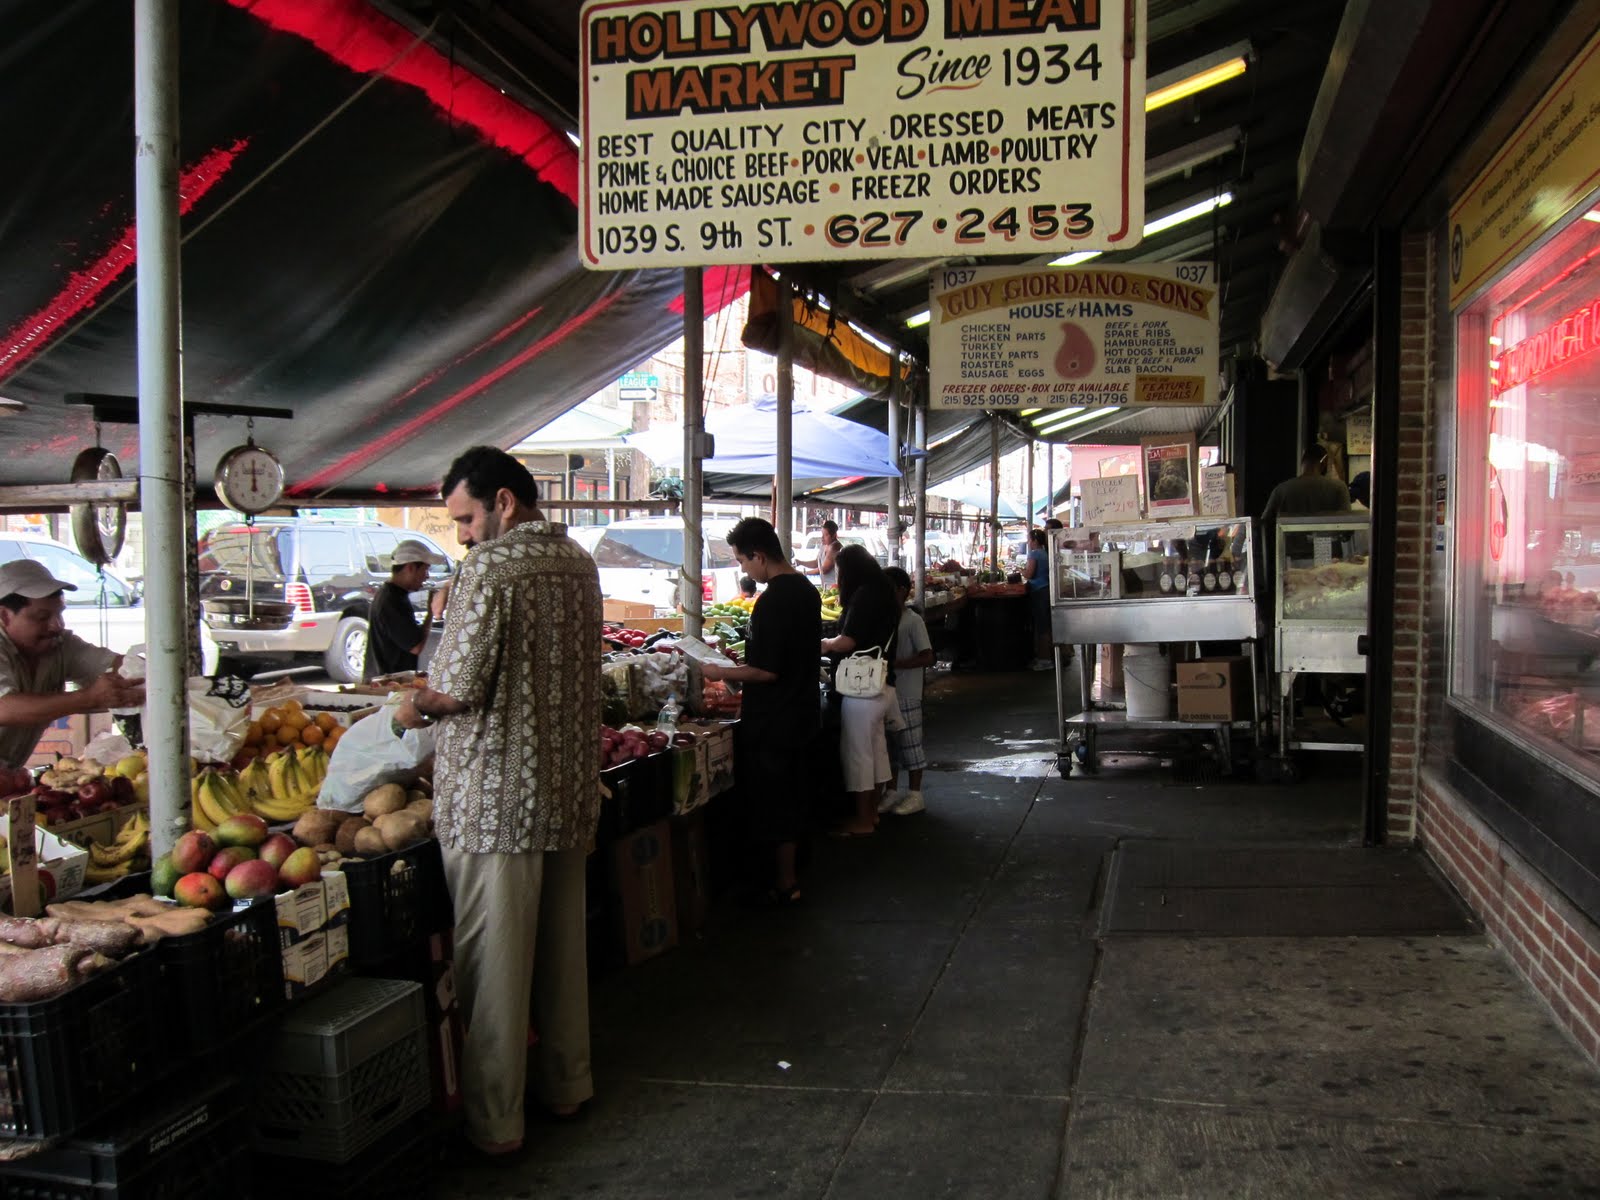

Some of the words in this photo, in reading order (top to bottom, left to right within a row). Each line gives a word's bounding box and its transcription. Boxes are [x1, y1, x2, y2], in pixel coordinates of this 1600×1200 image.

[590, 0, 929, 65] HOLLYWOOD
[896, 46, 992, 100] Since
[1002, 43, 1102, 86] 1934
[626, 54, 856, 120] MARKET
[598, 133, 653, 158] BEST
[671, 123, 784, 156] QUALITY
[803, 118, 866, 145] CITY
[890, 109, 1004, 140] DRESSED
[1027, 102, 1116, 131] MEATS
[598, 161, 650, 188] PRIME
[656, 165, 667, 184] &
[672, 155, 736, 182] CHOICE
[745, 152, 789, 178] BEEF
[802, 147, 855, 175] PORK
[867, 141, 919, 170] VEAL
[928, 139, 990, 167] LAMB
[1001, 133, 1098, 163] POULTRY
[598, 190, 649, 215] HOME
[656, 186, 713, 211] MADE
[721, 180, 820, 207] SAUSAGE
[852, 173, 931, 200] FREEZR
[949, 167, 1042, 195] ORDERS
[597, 224, 657, 255] 1039
[665, 224, 685, 252] S.
[700, 221, 742, 250] 9th
[757, 217, 792, 247] ST.
[825, 210, 923, 248] 627
[954, 203, 1094, 243] 2453
[943, 270, 977, 290] 1037
[1176, 265, 1208, 284] 1037
[947, 282, 994, 315] GUY
[1004, 272, 1128, 300] GIORDANO
[1131, 282, 1141, 296] &
[1146, 280, 1204, 313] SONS
[1009, 302, 1064, 319] HOUSE
[1079, 302, 1133, 317] HAMS
[961, 324, 1011, 333] CHICKEN
[1142, 321, 1168, 329] PORK
[961, 334, 1011, 342] CHICKEN
[1016, 333, 1046, 341] PARTS
[1105, 330, 1139, 338] SPARE
[1146, 329, 1171, 337] RIBS
[961, 343, 1003, 351] TURKEY
[1104, 339, 1176, 347] HAMBURGERS
[961, 352, 1003, 360] TURKEY
[1008, 351, 1039, 359] PARTS
[1104, 348, 1124, 356] HOT
[1127, 348, 1153, 356] DOGS
[1160, 347, 1203, 355] KIELBASI
[961, 361, 1014, 369] ROASTERS
[1173, 356, 1197, 364] PORK
[961, 370, 1008, 378] SAUSAGE
[1018, 369, 1045, 377] EGGS
[1105, 366, 1131, 374] SLAB
[1136, 365, 1172, 373] BACON
[619, 377, 648, 386] LEAGUE
[1142, 381, 1192, 392] FEATURE
[942, 384, 987, 394] FREEZER
[990, 384, 1026, 394] ORDERS
[1031, 383, 1050, 393] BOX
[1053, 383, 1075, 392] LOTS
[1078, 383, 1130, 392] AVAILABLE
[941, 396, 961, 406] (215)
[1047, 395, 1068, 405] (215)
